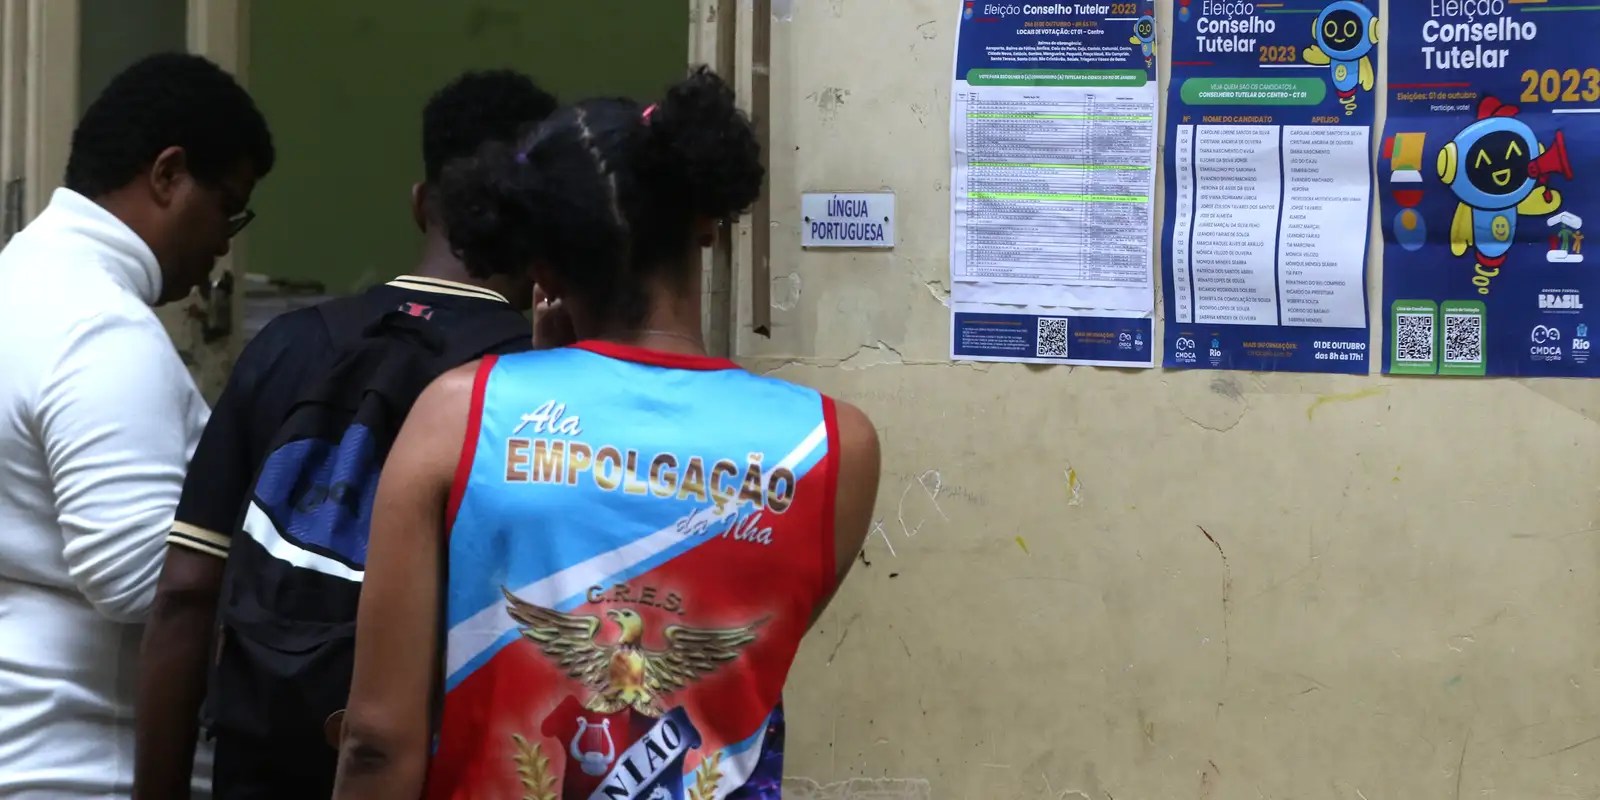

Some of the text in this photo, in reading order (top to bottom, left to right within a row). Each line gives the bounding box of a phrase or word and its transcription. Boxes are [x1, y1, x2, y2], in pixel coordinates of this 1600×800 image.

[984, 4, 1136, 18] Eleição Conselho Tutelar 2023
[1202, 0, 1253, 19] Eleição
[1196, 17, 1275, 34] Conselho
[1422, 17, 1537, 42] Conselho
[1196, 35, 1256, 52] Tutelar
[1259, 46, 1296, 62] 2023
[1421, 44, 1509, 69] Tutelar
[1520, 68, 1600, 102] 2023
[1397, 92, 1428, 102] Eleições:
[828, 194, 868, 218] LÍNGUA
[811, 222, 884, 241] PORTUGUESA
[1538, 294, 1583, 309] BRASIL
[1572, 338, 1590, 350] Rio
[513, 399, 582, 436] Ala
[504, 437, 796, 516] EMPOLGAÇÃO
[676, 508, 773, 545] da Ilha
[587, 584, 685, 616] G.R.E.S.
